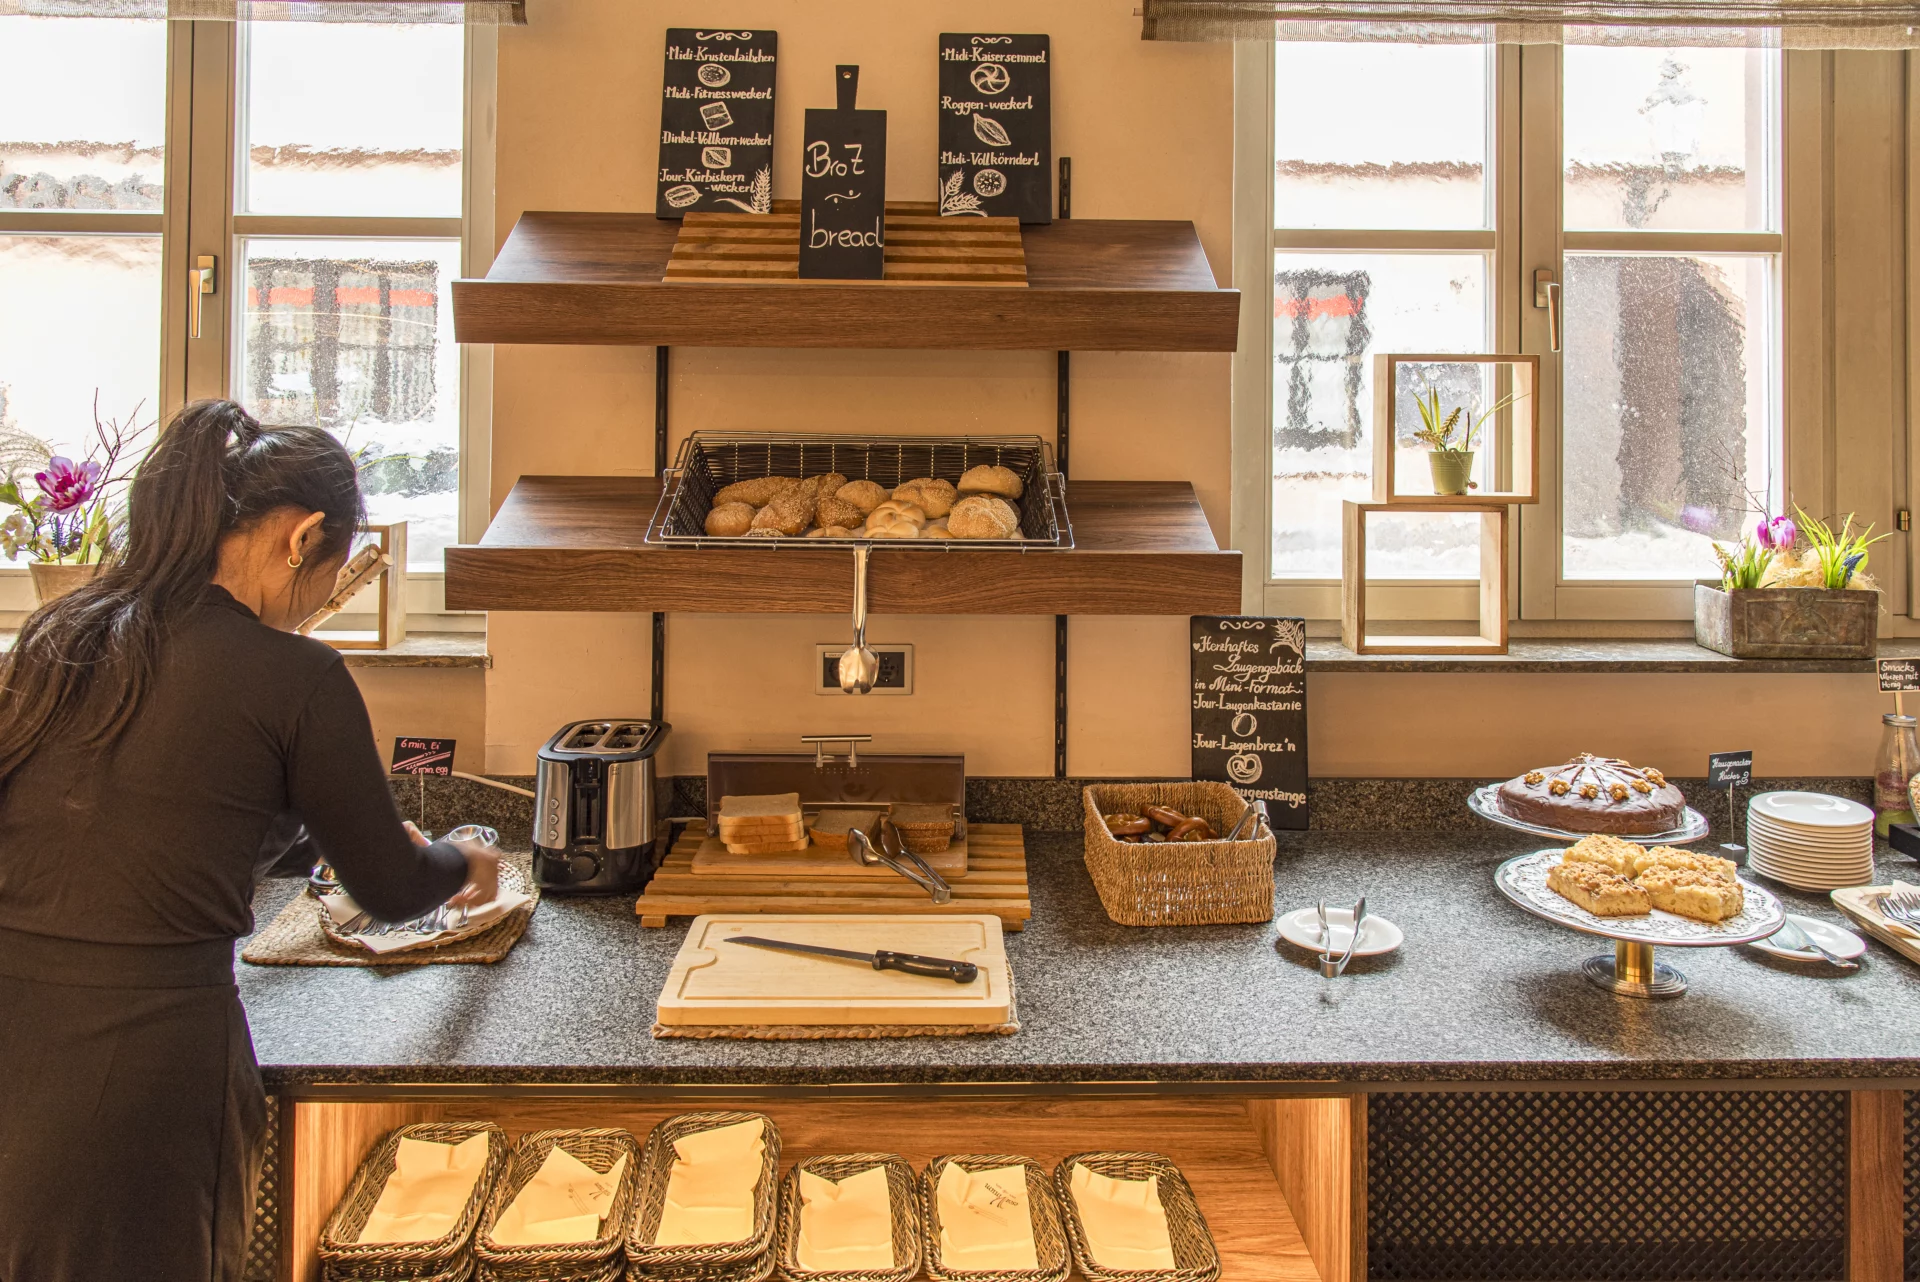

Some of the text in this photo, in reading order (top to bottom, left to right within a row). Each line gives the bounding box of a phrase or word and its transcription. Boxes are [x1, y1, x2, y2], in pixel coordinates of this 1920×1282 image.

[944, 47, 1046, 63] Midi-Kaisersemmel
[665, 86, 772, 99] Midi-Fitnessweckerl
[942, 95, 1033, 115] Roggen-weckerl
[808, 208, 884, 248] bread
[1199, 635, 1259, 656] Herzhaftes
[1213, 654, 1304, 683] Laugengebäck
[1881, 661, 1915, 672] Smacks
[1195, 679, 1206, 690] in
[1882, 681, 1901, 690] Honig
[1193, 693, 1302, 714] Jour-Laugenkastanie
[401, 739, 408, 748] 6
[430, 741, 441, 750] Ei
[411, 767, 418, 775] 6
[435, 766, 449, 776] egg
